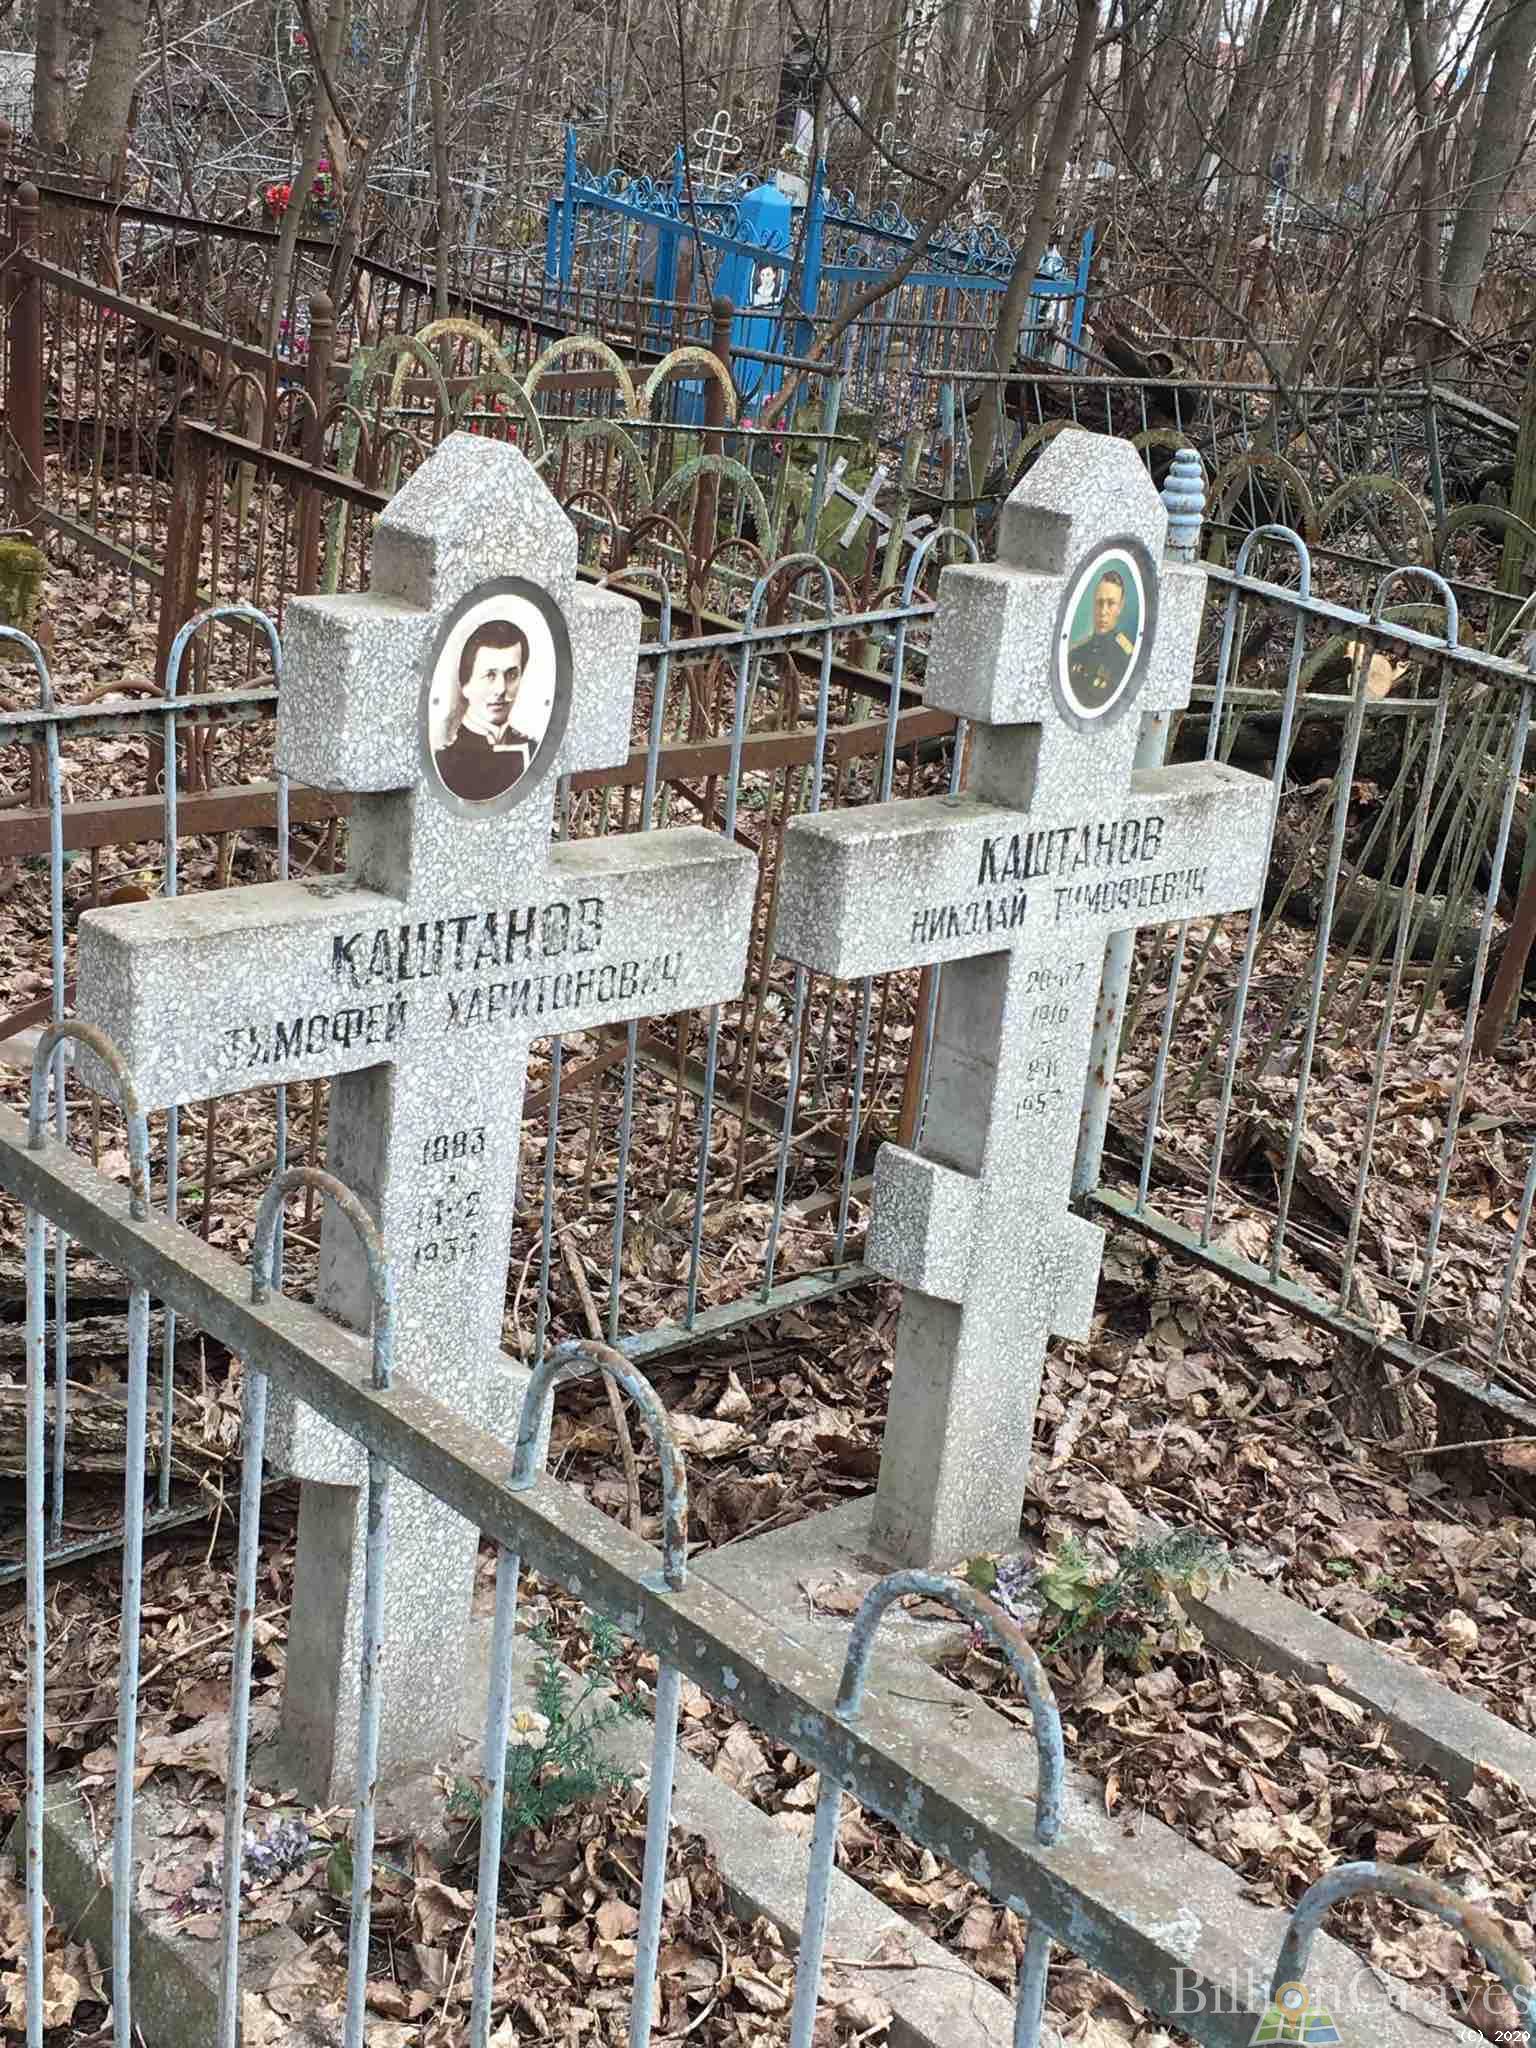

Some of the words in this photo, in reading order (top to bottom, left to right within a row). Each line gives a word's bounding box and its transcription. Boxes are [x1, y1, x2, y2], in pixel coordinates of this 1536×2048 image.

[979, 815, 1165, 885] КАШТАНОВ
[330, 897, 605, 986] КАШТАНОВ
[910, 887, 1028, 944] НИКОЛАЙ
[422, 1126, 486, 1166] 1883
